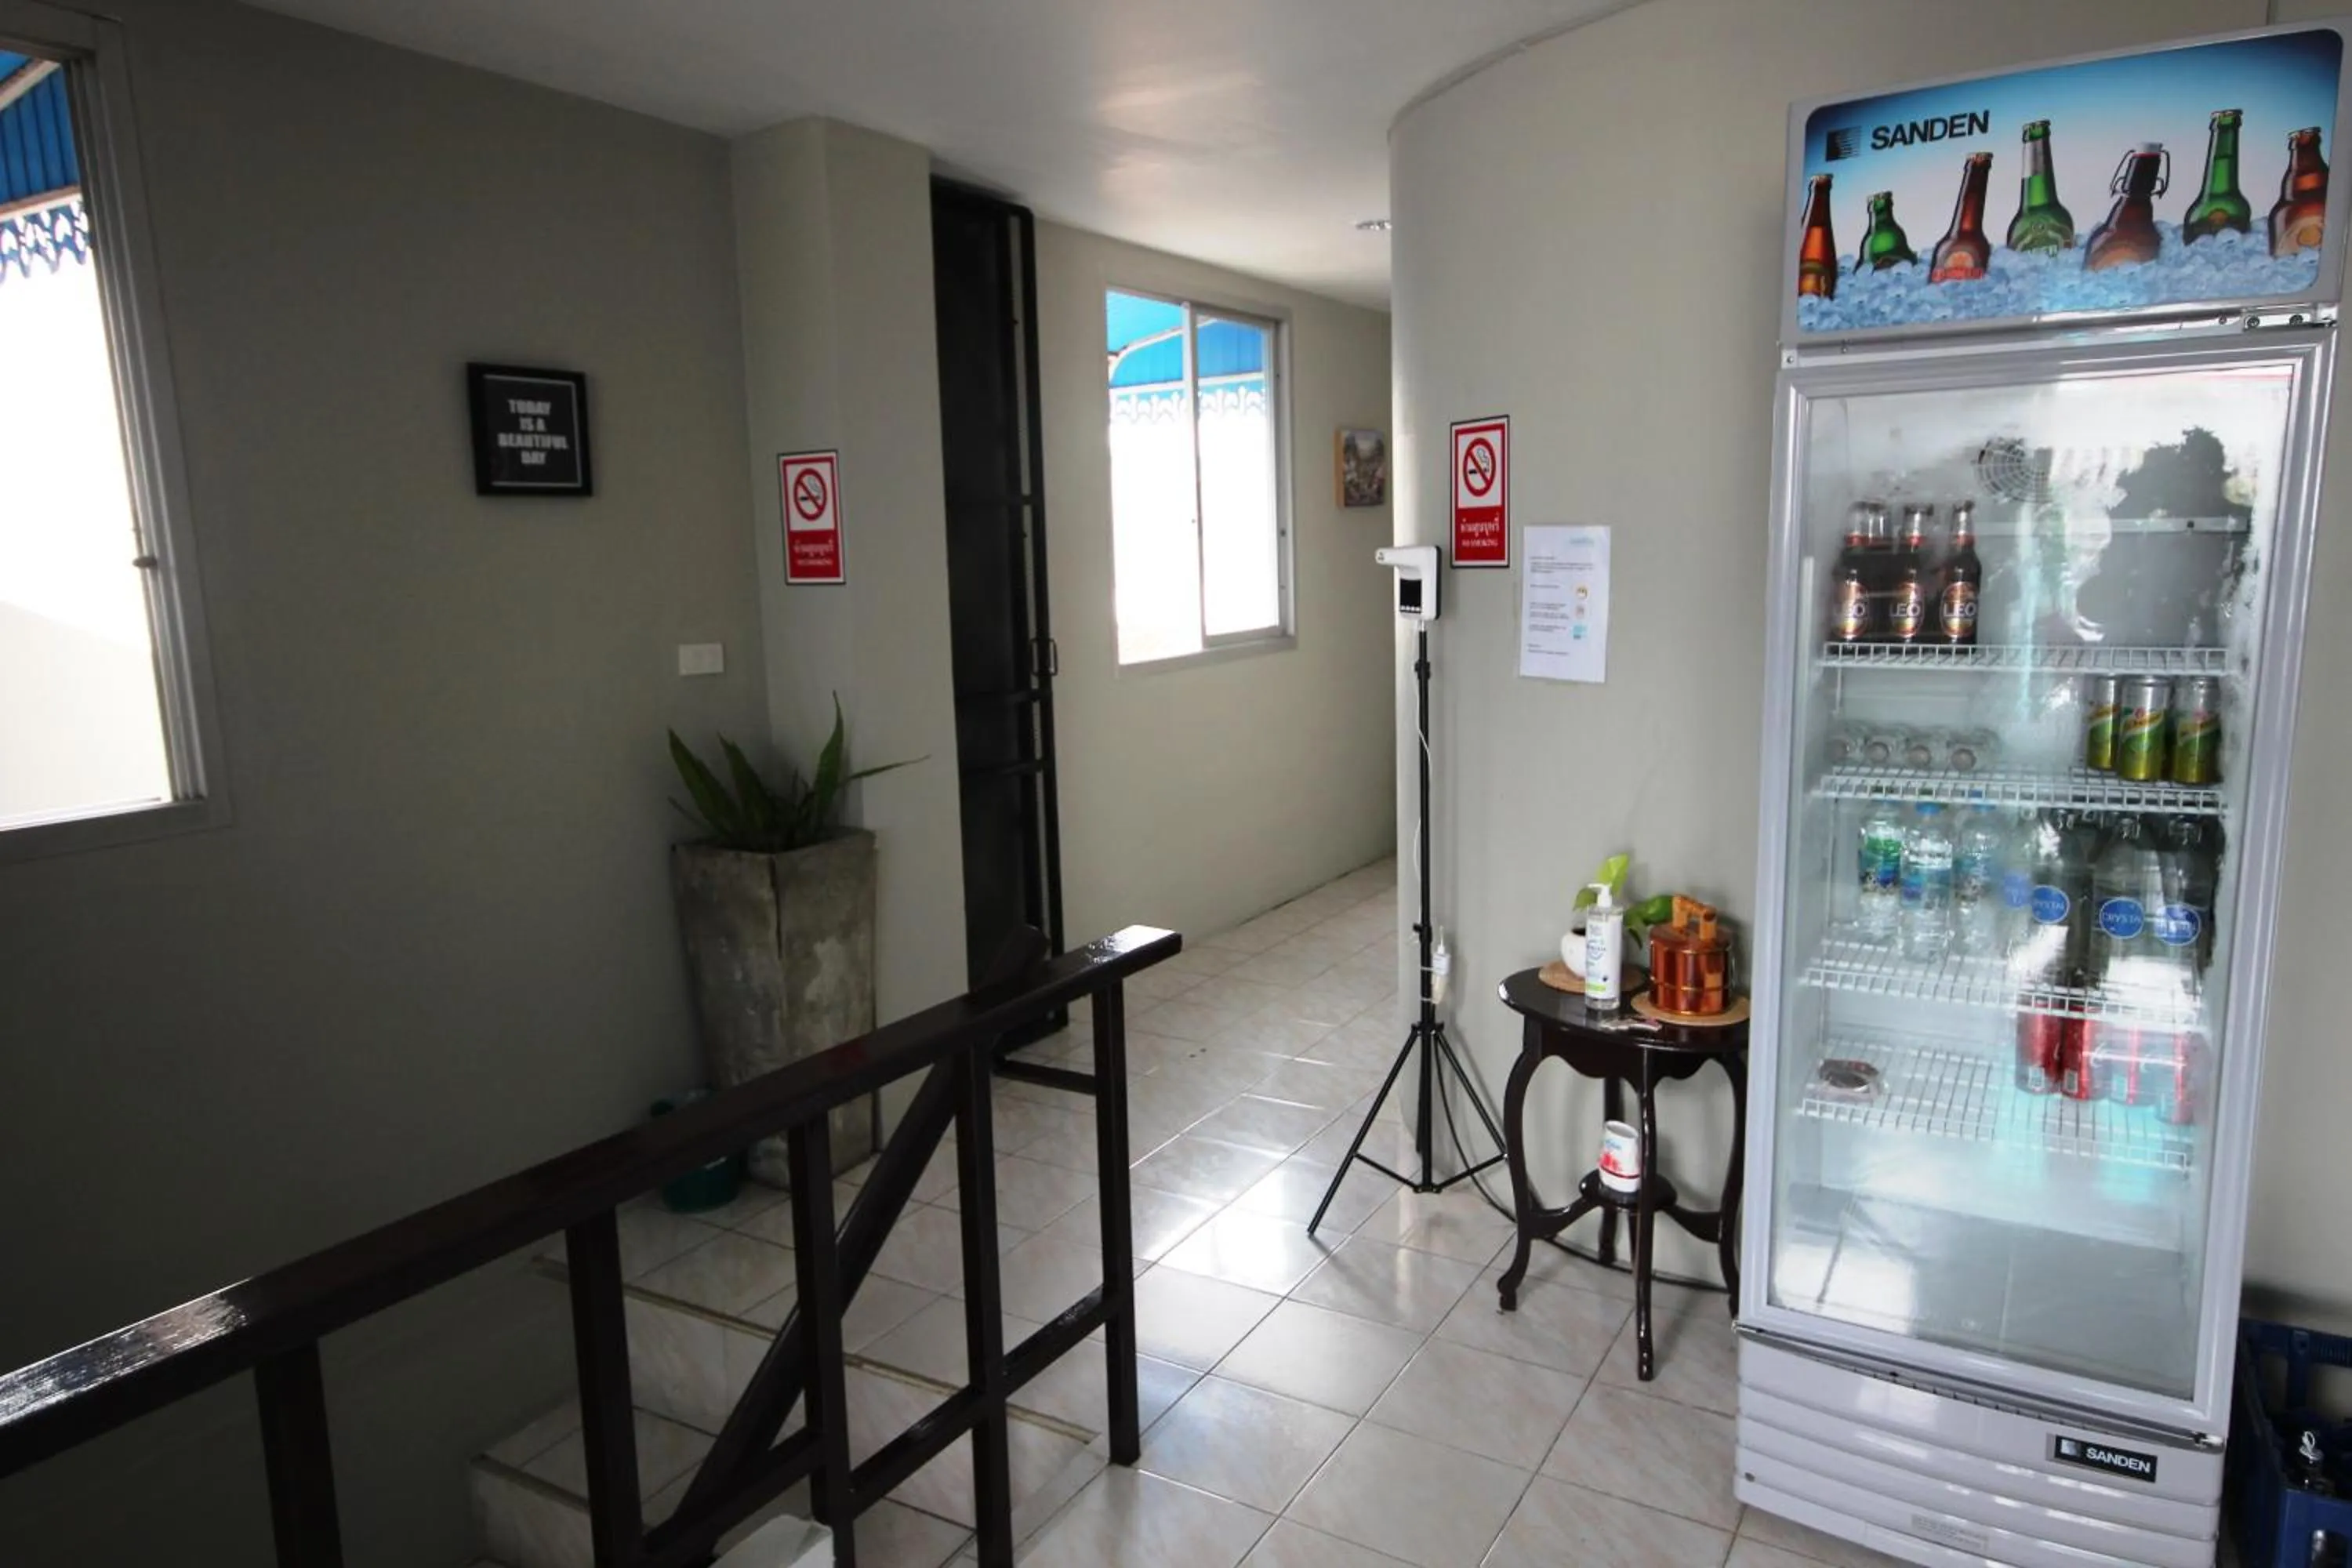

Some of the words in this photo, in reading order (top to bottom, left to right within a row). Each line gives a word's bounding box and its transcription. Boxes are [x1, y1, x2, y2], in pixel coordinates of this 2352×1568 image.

[1871, 110, 1989, 150] SANDEN
[508, 399, 550, 416] TODAY
[519, 417, 534, 430] IS
[536, 417, 546, 431] A
[498, 433, 568, 449] BEAUTIFUL
[521, 450, 546, 464] DAY
[1889, 603, 1920, 617] LEO
[1944, 602, 1976, 617] LEO
[2086, 1447, 2151, 1473] SANDEN
